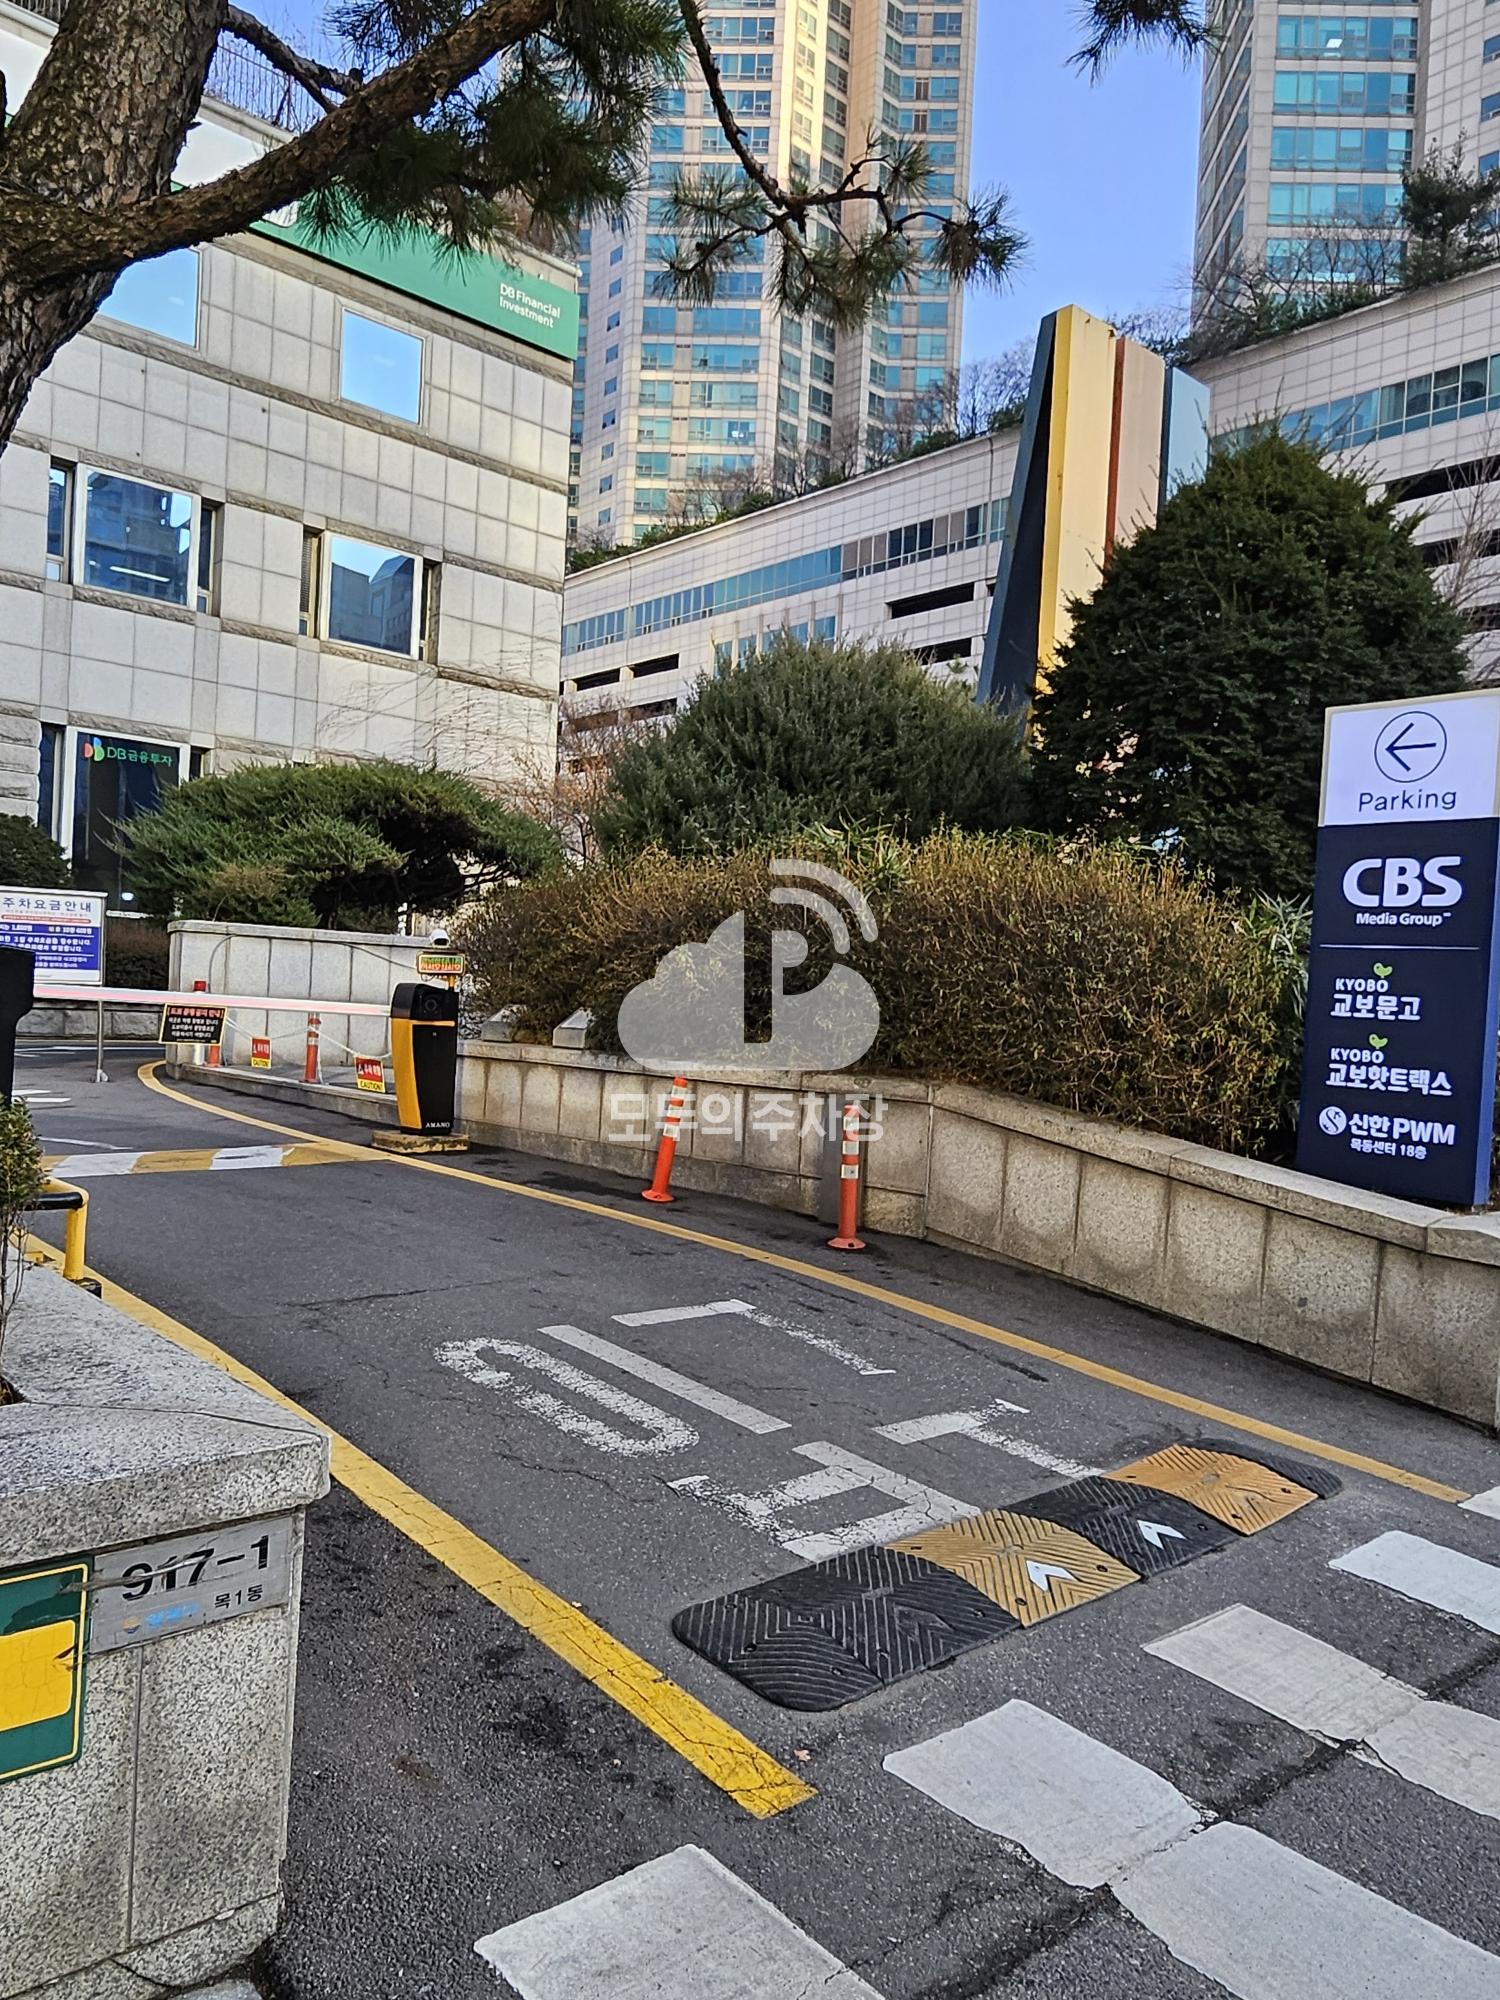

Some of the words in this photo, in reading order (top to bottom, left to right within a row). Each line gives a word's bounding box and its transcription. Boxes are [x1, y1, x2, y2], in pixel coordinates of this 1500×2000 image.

[500, 282, 516, 299] DB
[516, 290, 561, 319] Financial
[500, 296, 554, 328] Investment
[107, 746, 172, 767] DB금융투자
[1358, 788, 1457, 812] Parking
[1342, 855, 1463, 908] CBS
[1356, 912, 1398, 925] Media
[1335, 978, 1389, 993] KYOBO
[1330, 993, 1421, 1021] 교보문고
[1330, 1048, 1384, 1063] KYOBO
[1325, 1063, 1453, 1096] 교보핫트랙스
[1348, 1113, 1391, 1138] 신한
[1392, 1117, 1456, 1145] PWM
[1350, 1138, 1396, 1156] 목동센터
[1400, 1144, 1427, 1159] 18층
[122, 1534, 269, 1601] 917-1
[214, 1584, 263, 1609] 목1동
